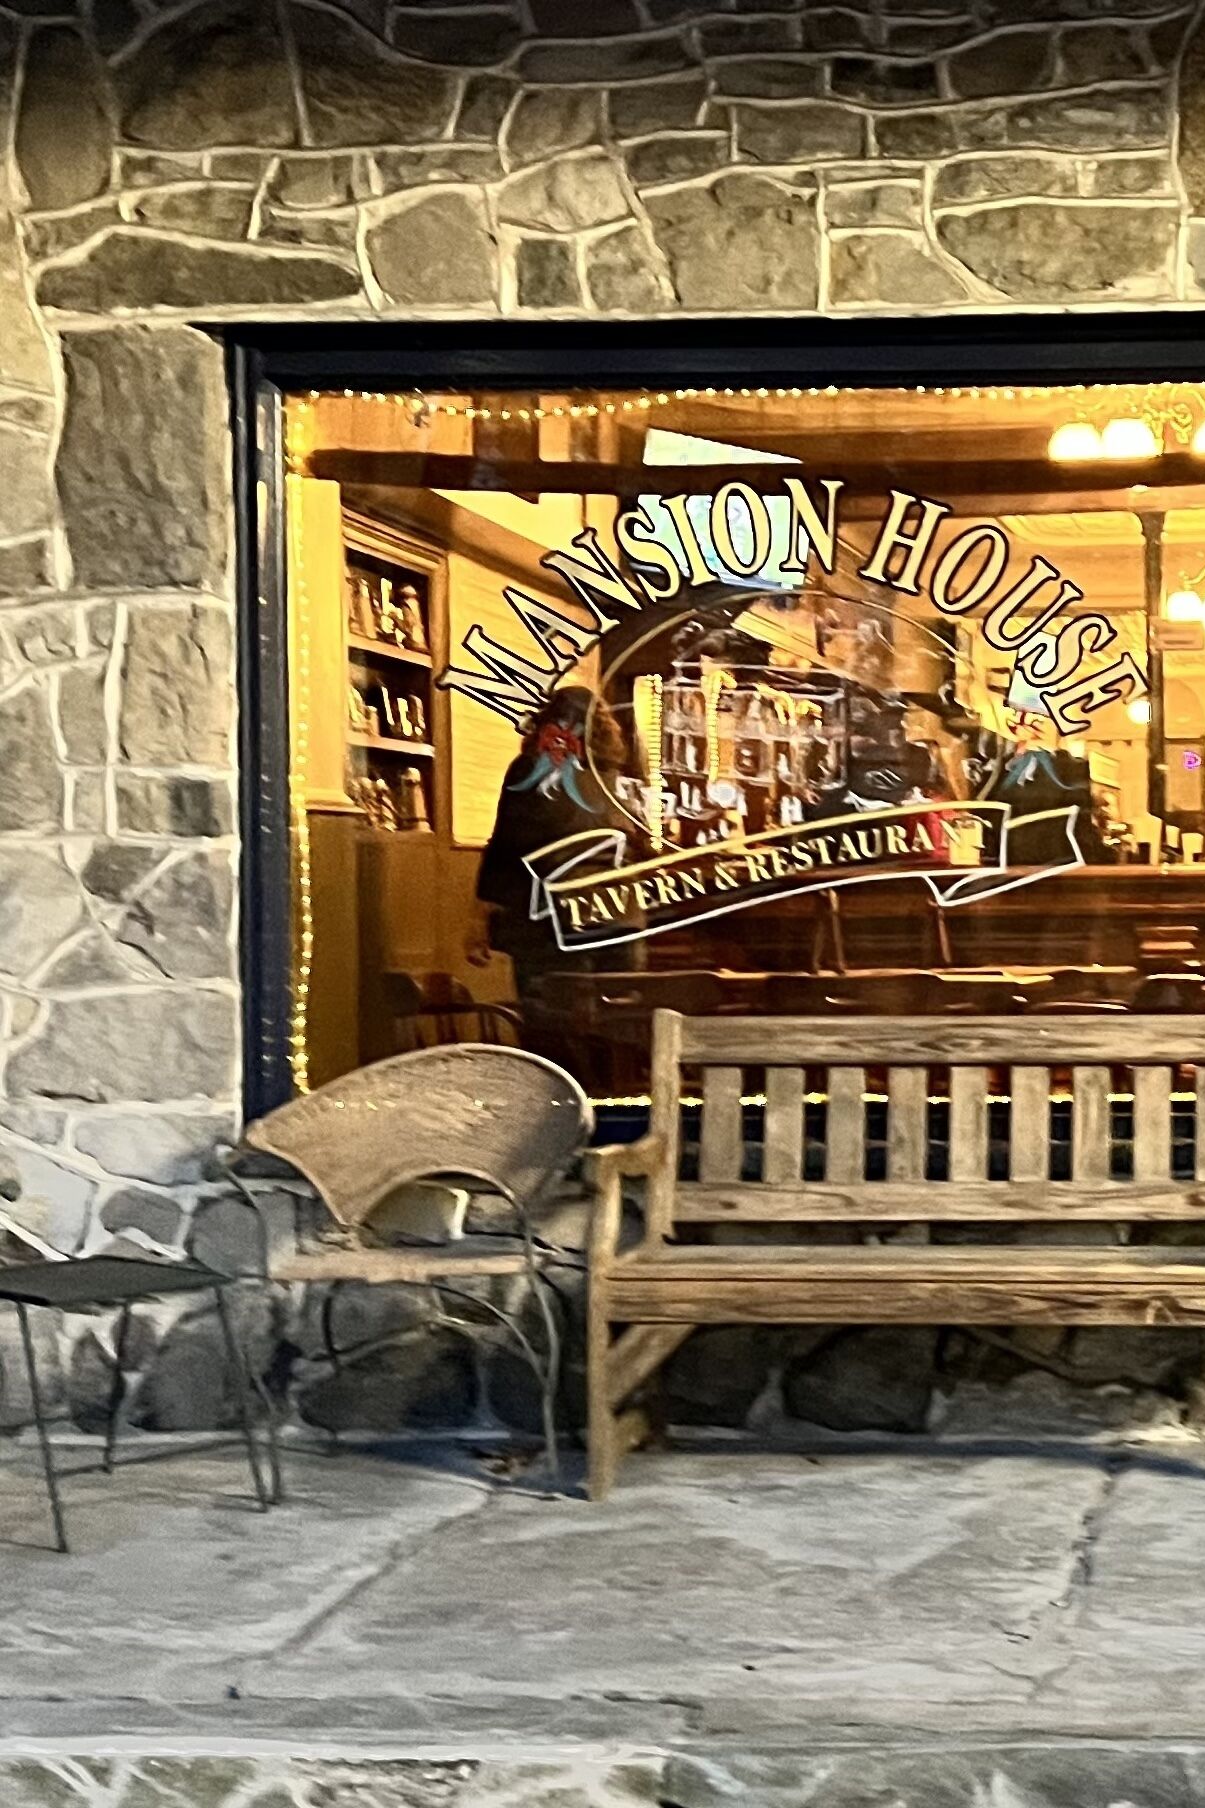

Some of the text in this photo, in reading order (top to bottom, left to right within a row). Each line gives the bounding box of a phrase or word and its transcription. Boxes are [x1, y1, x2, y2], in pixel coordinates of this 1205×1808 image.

[437, 477, 1148, 735] MANSION HOUSE
[562, 815, 992, 932] TAVERN & RESTAURANT
